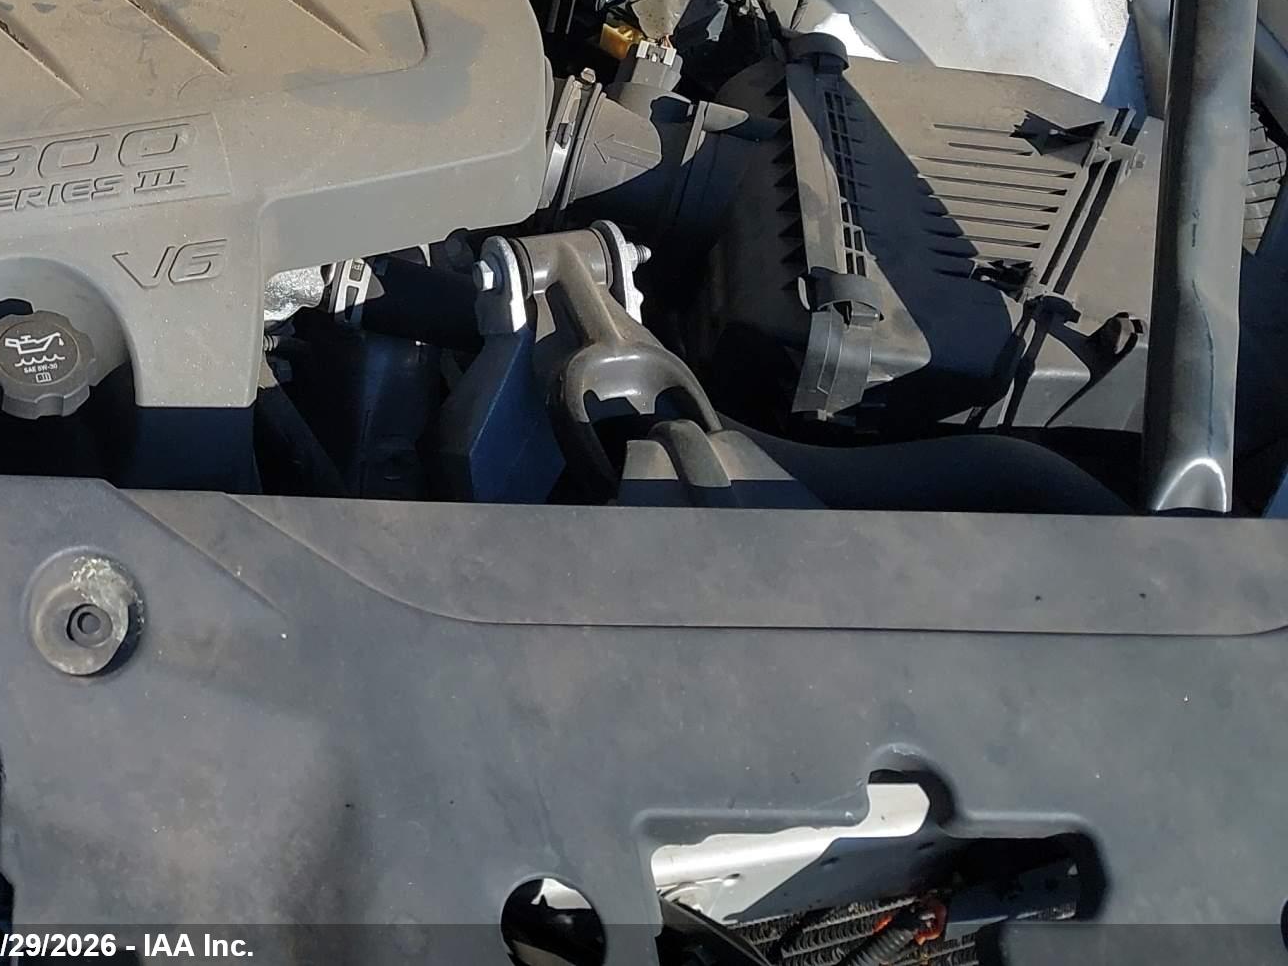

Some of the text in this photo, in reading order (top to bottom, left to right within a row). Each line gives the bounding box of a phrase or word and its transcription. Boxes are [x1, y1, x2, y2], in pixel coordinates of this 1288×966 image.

[133, 165, 189, 194] III
[112, 238, 228, 290] V6
[23, 365, 37, 374] SAE
